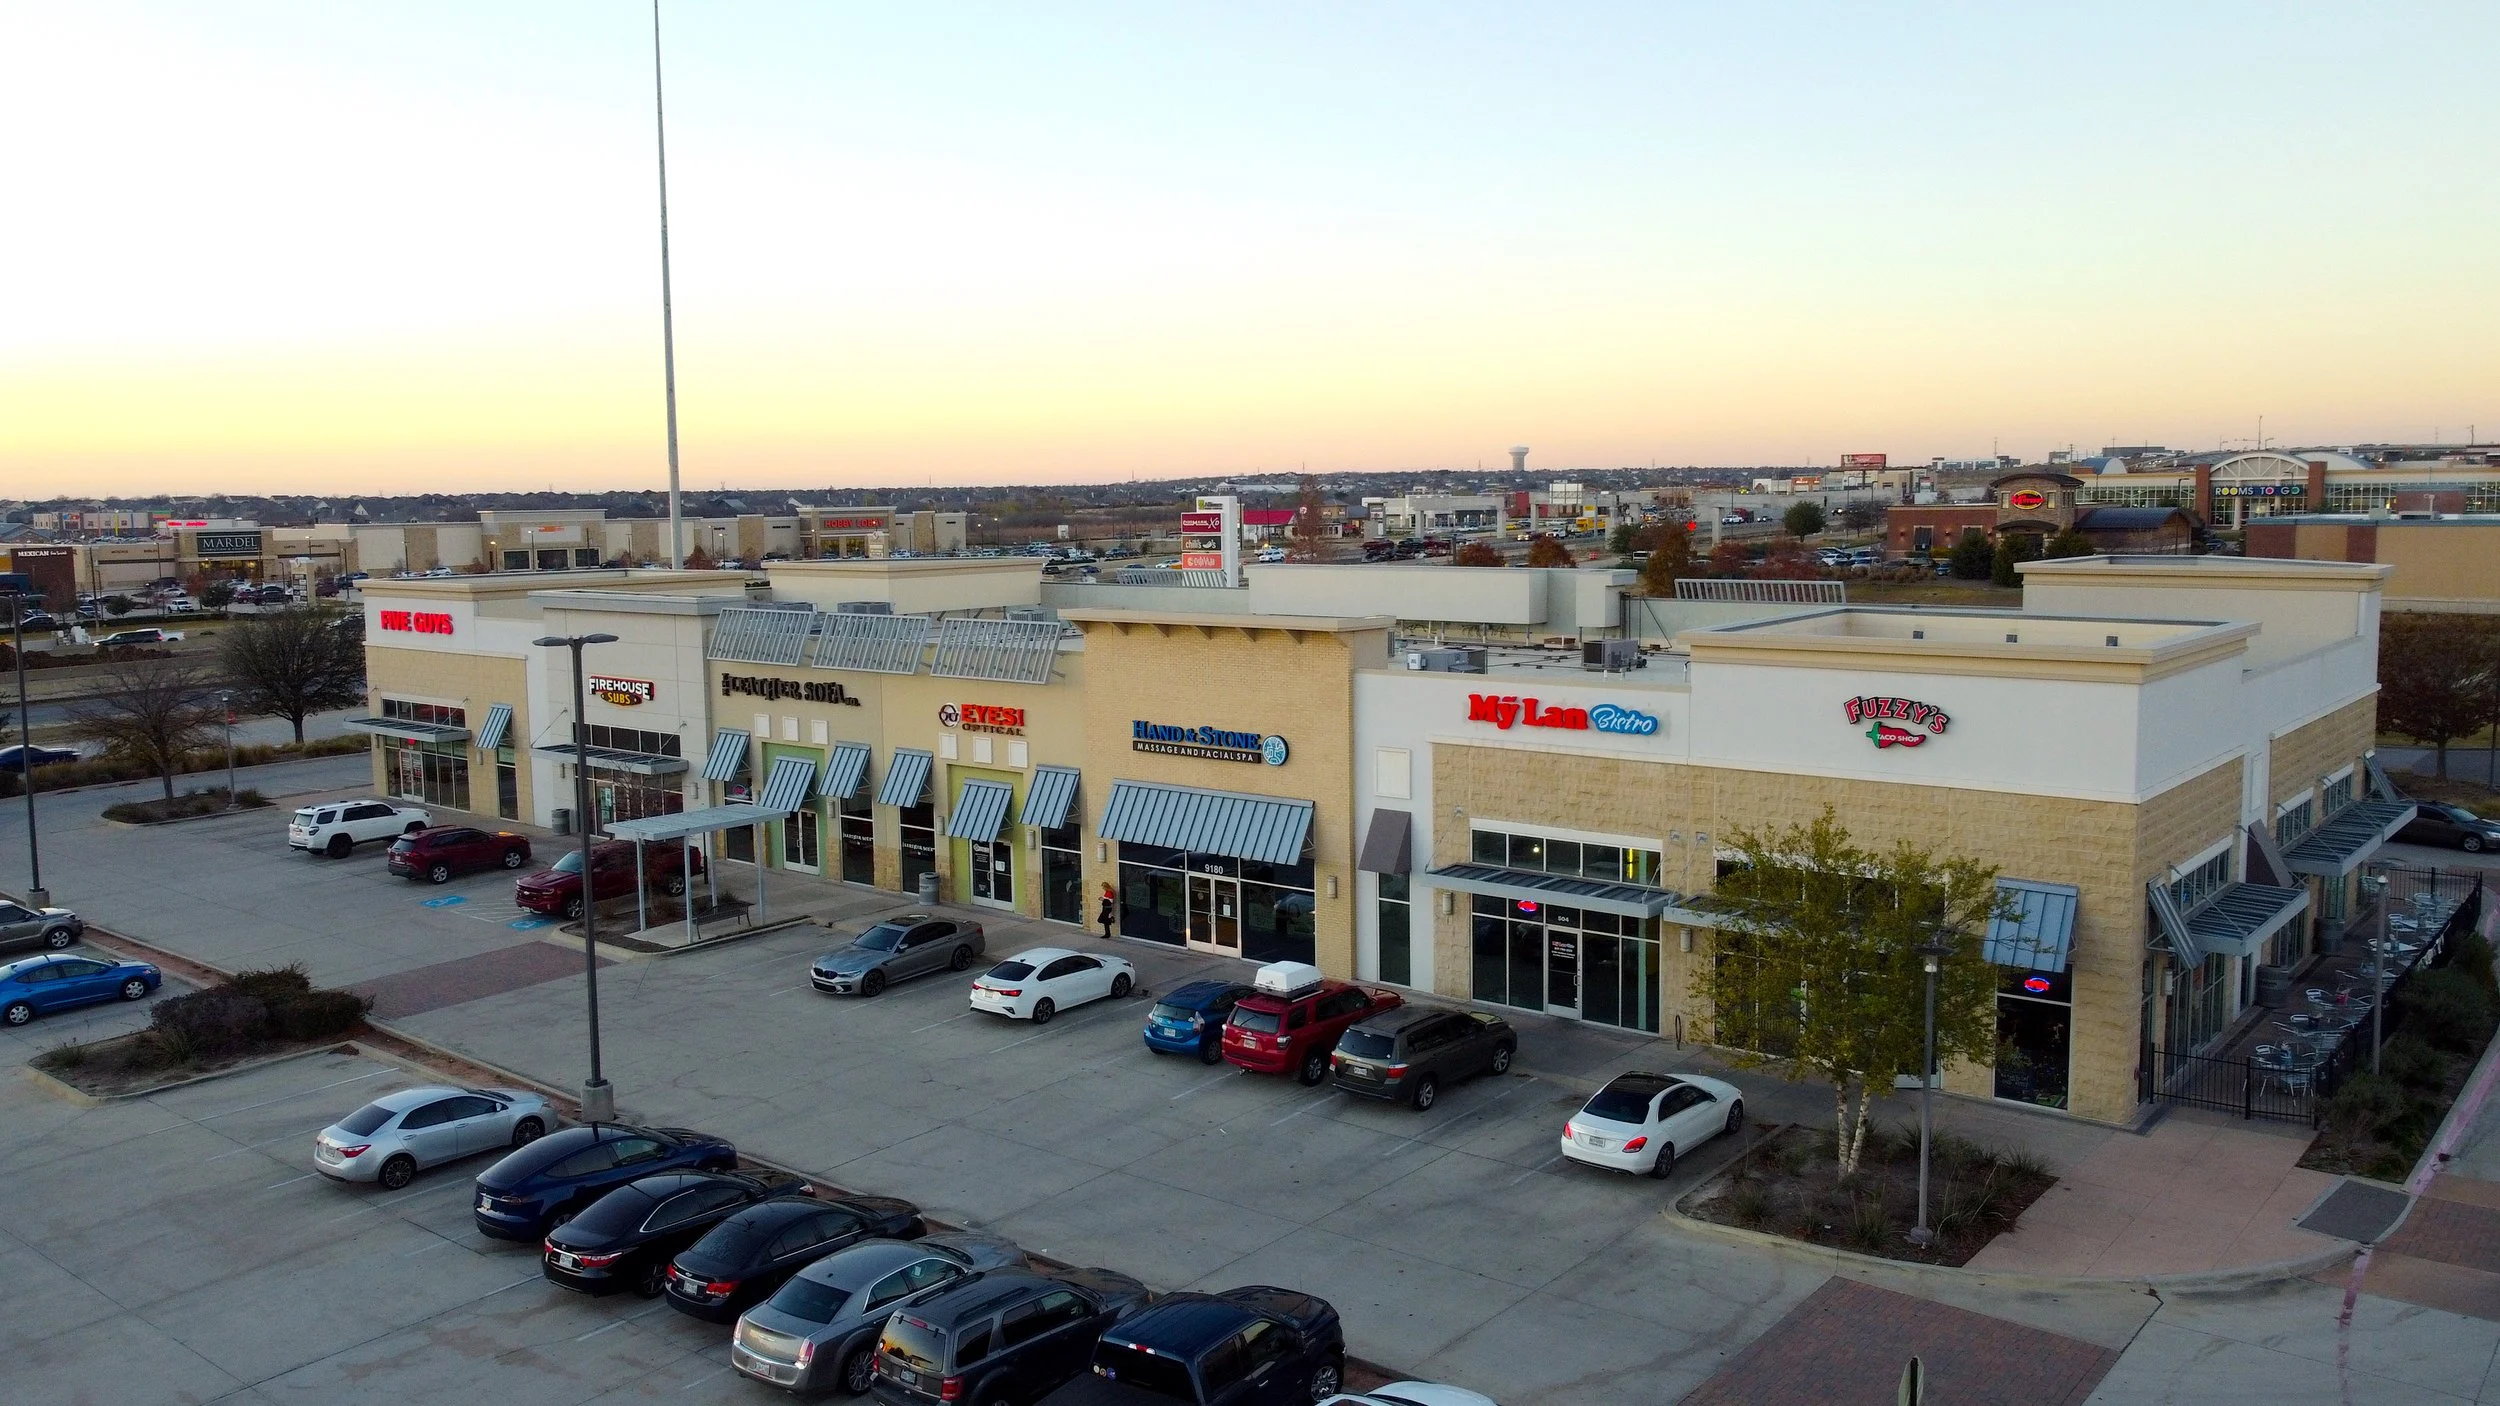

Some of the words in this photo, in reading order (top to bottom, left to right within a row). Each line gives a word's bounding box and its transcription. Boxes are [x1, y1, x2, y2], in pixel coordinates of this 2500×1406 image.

[2215, 487, 2254, 496] ROOMS
[2260, 486, 2275, 496] TO
[2280, 486, 2300, 495] GO
[824, 518, 853, 528] HOBBY
[856, 518, 884, 528] LOBBY
[203, 537, 257, 548] MARDEL
[380, 610, 412, 631] FIVE
[413, 612, 454, 635] GUYS
[589, 678, 651, 700] FIREHOUSE
[729, 676, 802, 701] LEATHER
[804, 681, 845, 704] SOFA
[607, 692, 631, 704] SUBS
[1522, 698, 1588, 730] Lan
[1592, 707, 1653, 732] Bistro
[1844, 696, 1950, 734] FUZZY'S
[962, 722, 1026, 737] OPTICAL
[1185, 728, 1199, 743] &
[1876, 733, 1896, 741] TACO
[1898, 735, 1919, 743] SHOP
[1137, 743, 1178, 754] MASSAGE
[1180, 747, 1199, 757] AND
[1201, 749, 1234, 760] FACIAL
[1236, 753, 1254, 762] SPA
[1204, 864, 1224, 875] 9180
[1557, 915, 1570, 923] 504
